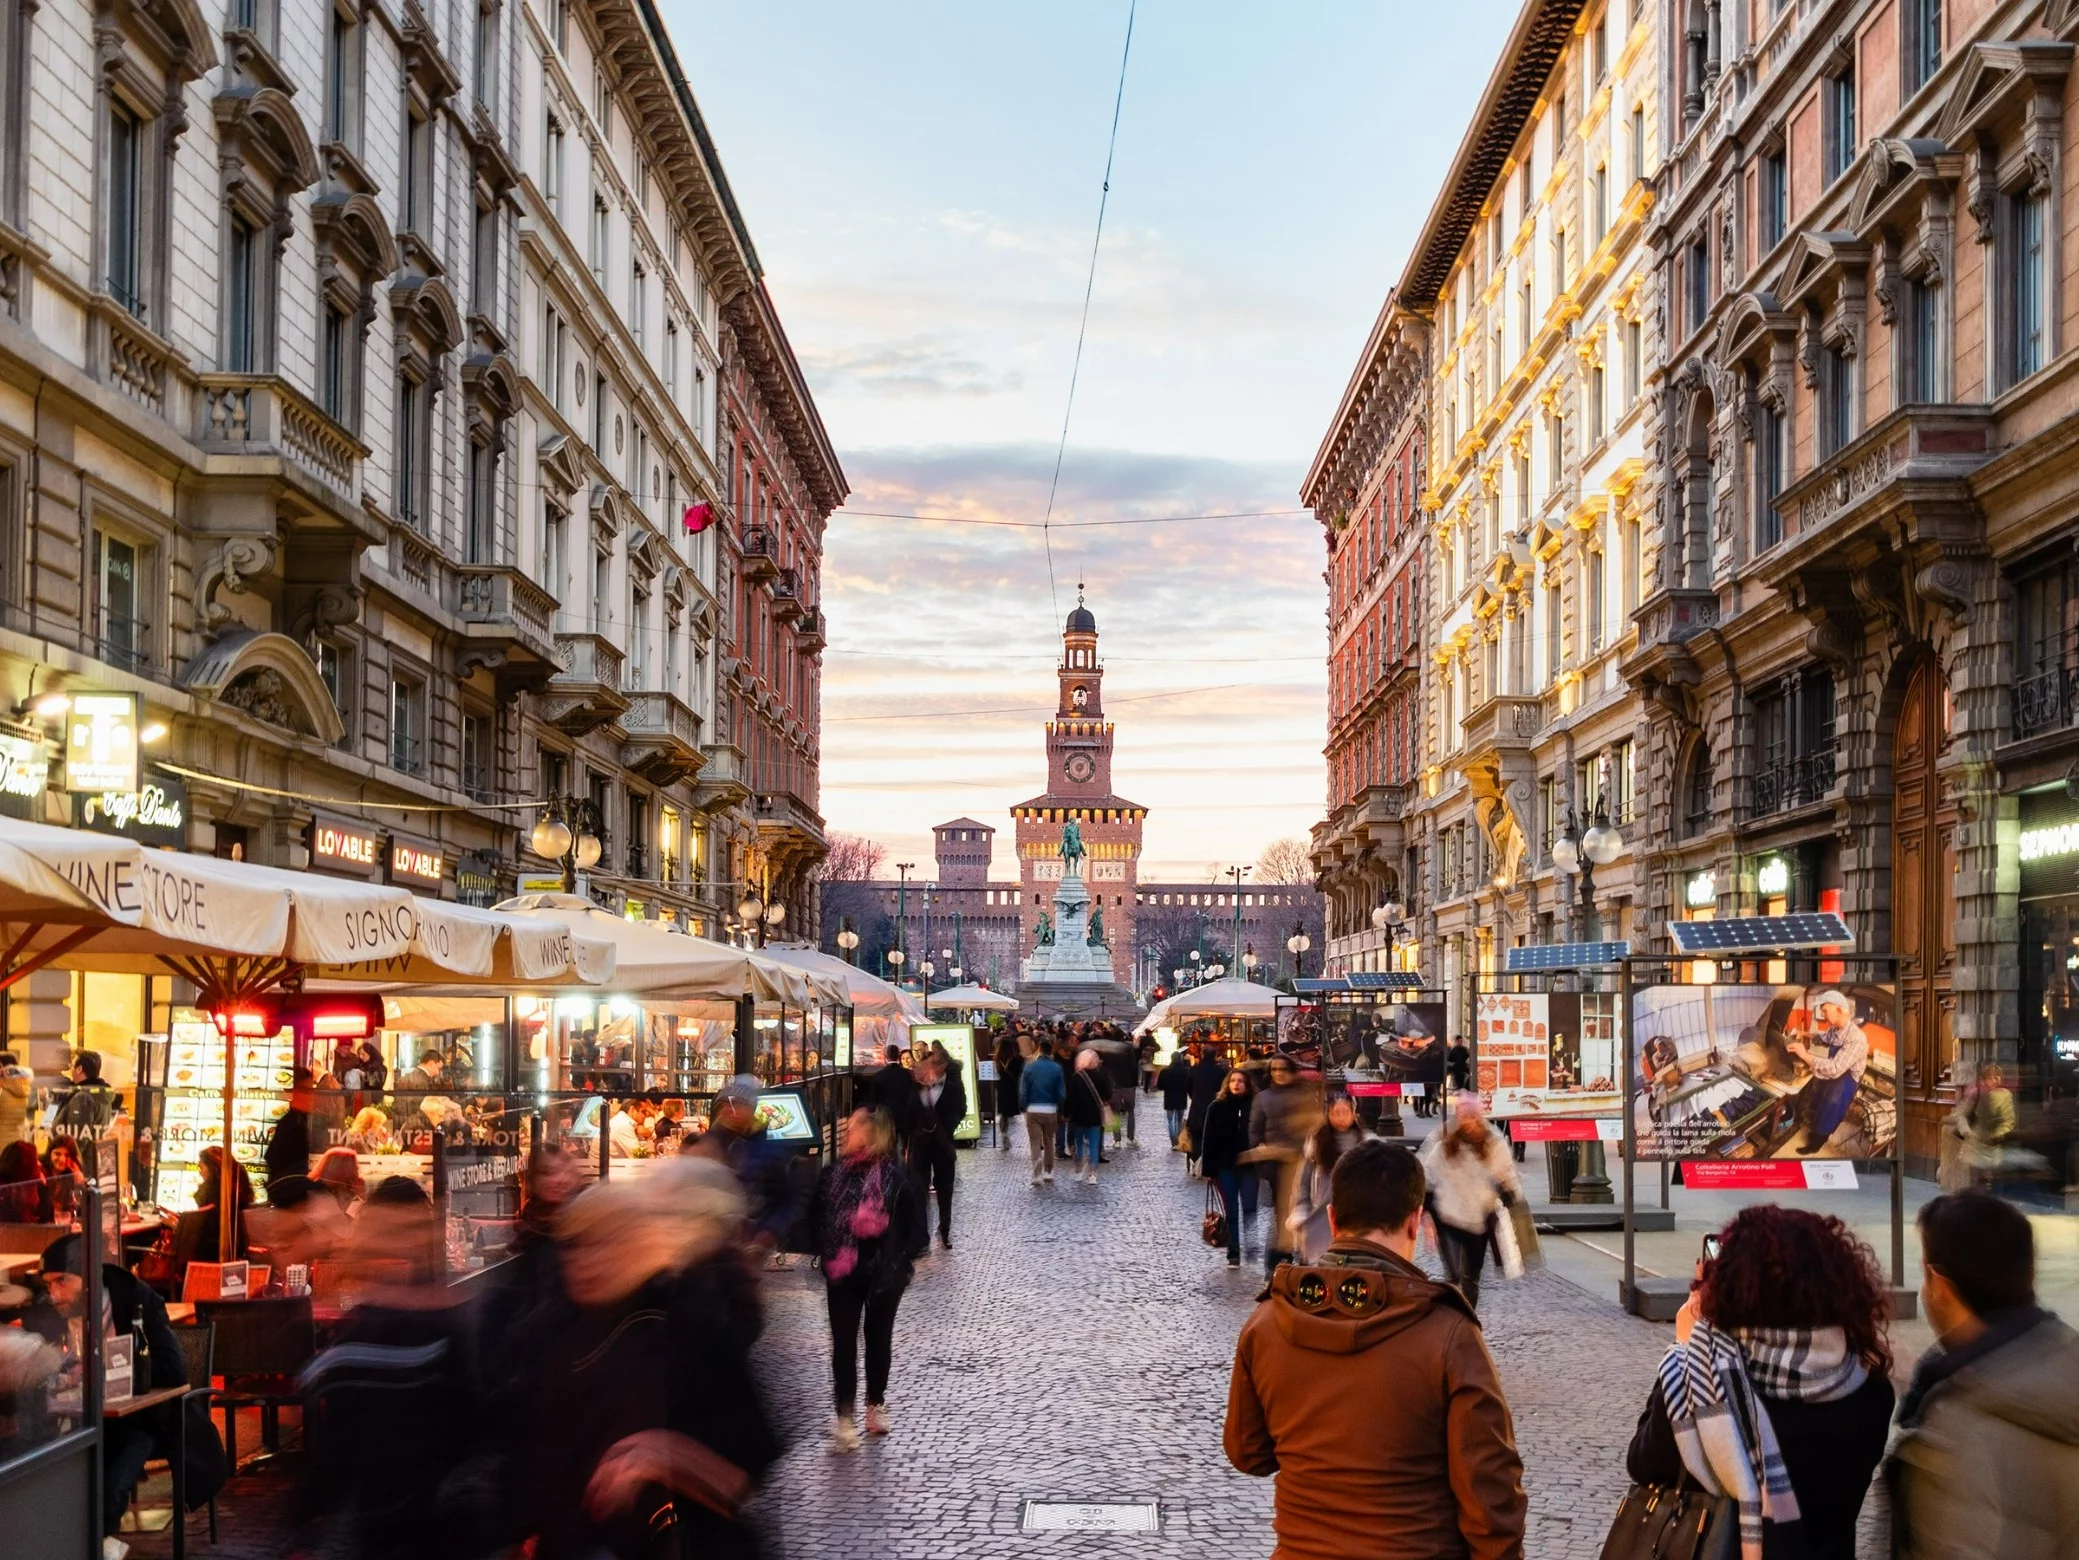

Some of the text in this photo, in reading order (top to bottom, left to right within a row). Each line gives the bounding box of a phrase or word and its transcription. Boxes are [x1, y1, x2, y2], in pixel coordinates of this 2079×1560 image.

[318, 827, 373, 864] LOVABLE
[394, 847, 441, 879] LOVABLE
[539, 935, 570, 967] WINE
[237, 1089, 276, 1100] Bistrot
[1651, 1128, 1671, 1138] guida
[1673, 1128, 1680, 1136] la
[1681, 1128, 1699, 1137] lama
[1700, 1128, 1717, 1137] sulla
[1717, 1128, 1736, 1137] mola
[1636, 1138, 1657, 1146] come
[1664, 1137, 1688, 1147] pittore
[1689, 1137, 1711, 1148] guida
[1642, 1146, 1674, 1156] pennello
[1692, 1146, 1707, 1155] tela
[1695, 1163, 1777, 1171] Coltelleria Arrotino Polli
[447, 1167, 466, 1191] WINE
